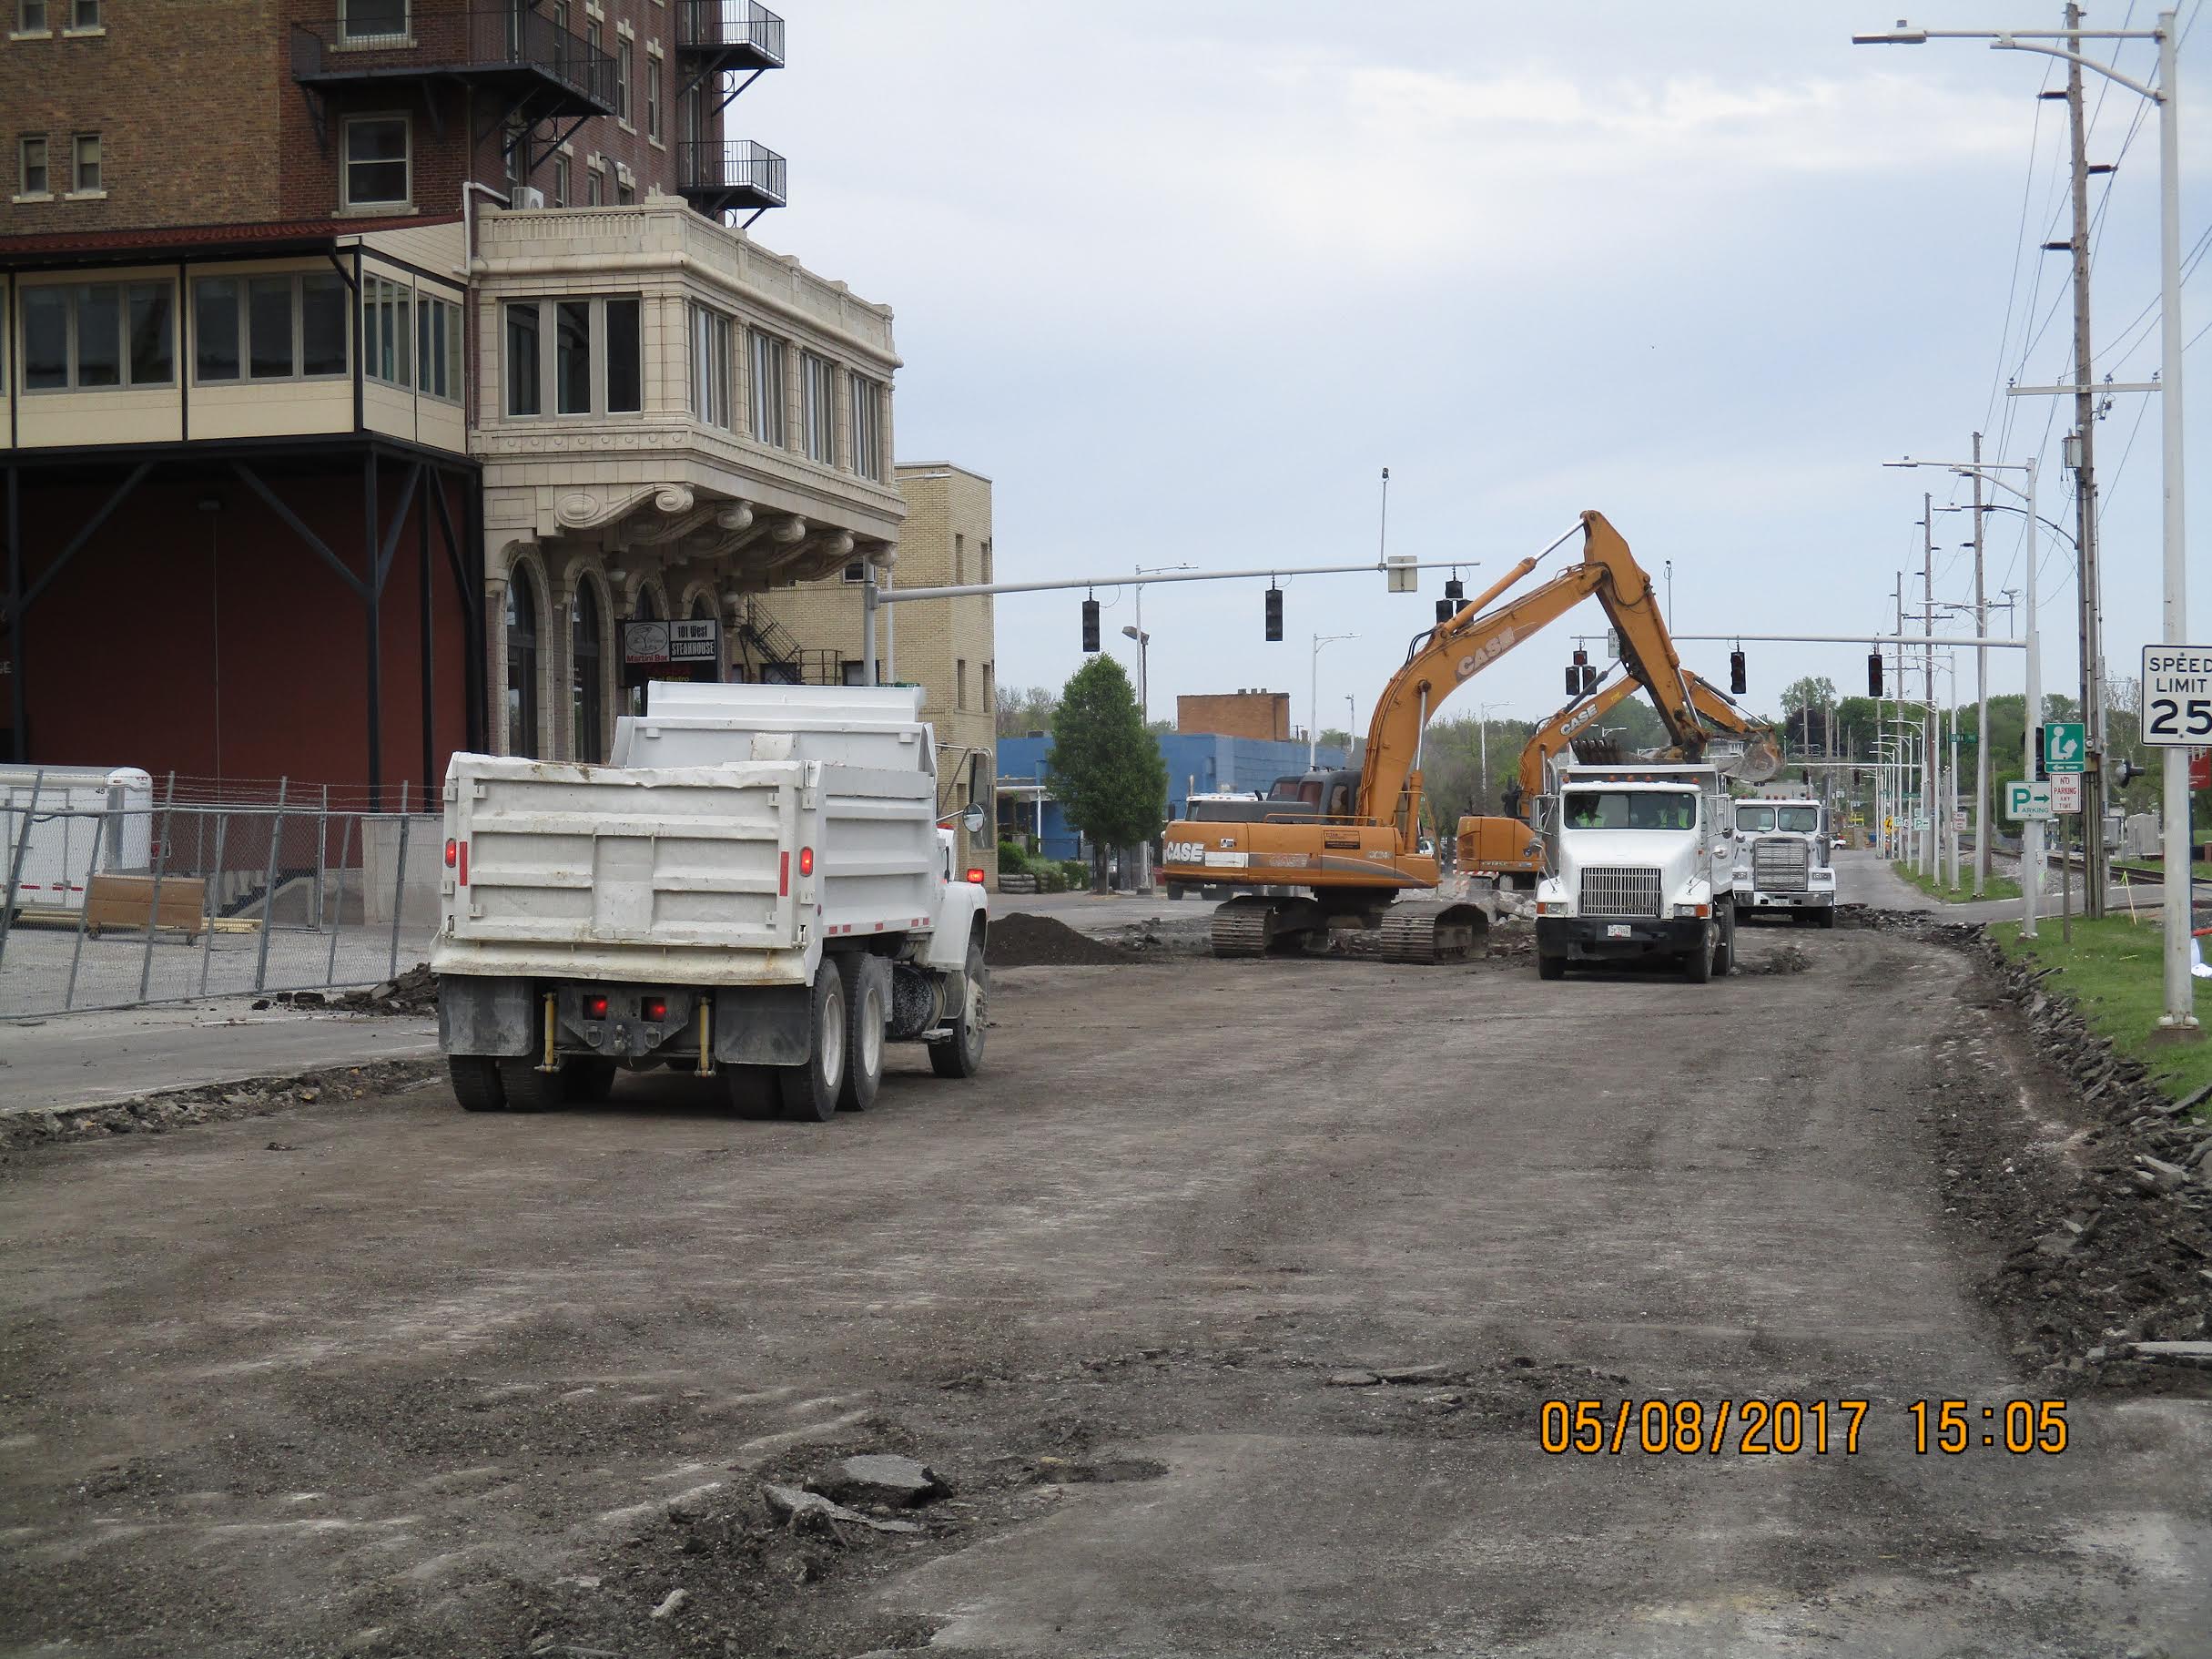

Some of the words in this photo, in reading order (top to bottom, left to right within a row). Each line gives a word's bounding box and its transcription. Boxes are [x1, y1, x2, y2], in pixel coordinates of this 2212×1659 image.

[677, 626, 688, 637] 101
[690, 626, 707, 637] West
[671, 641, 715, 656] STEAKHOUSE
[1457, 626, 1515, 675] CASE
[626, 654, 654, 662] Martini
[2149, 657, 2212, 673] SPEED
[2156, 677, 2207, 693] LIMIT
[1560, 703, 1598, 736] CASE
[2150, 698, 2212, 735] 25
[2053, 787, 2077, 795] PARKING
[1167, 841, 1205, 862] CASE
